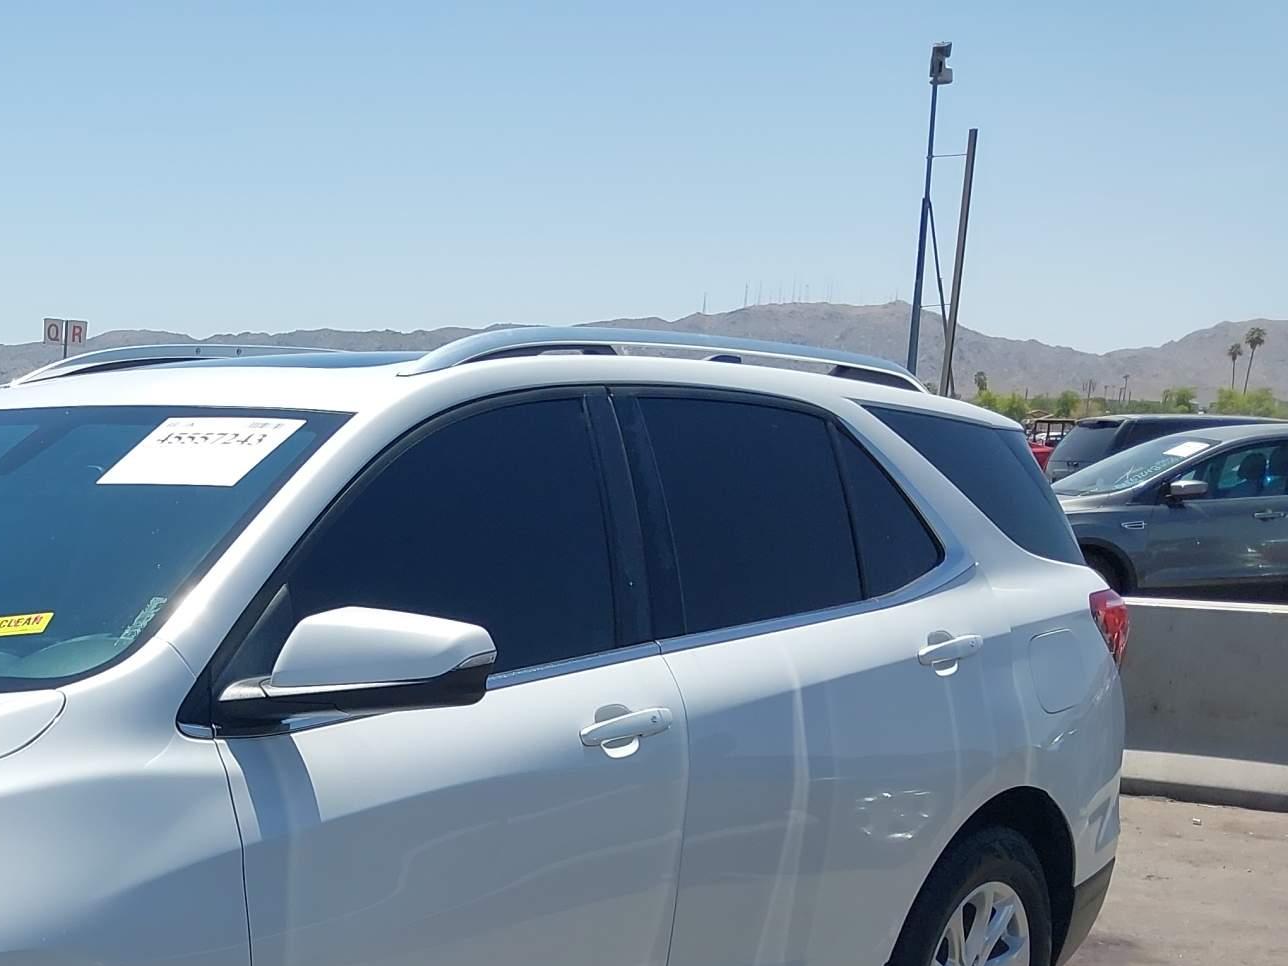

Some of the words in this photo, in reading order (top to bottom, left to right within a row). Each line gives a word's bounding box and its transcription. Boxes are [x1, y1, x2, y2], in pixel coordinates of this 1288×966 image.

[47, 323, 59, 342] Q
[72, 325, 83, 343] R
[157, 432, 268, 446] 45557243
